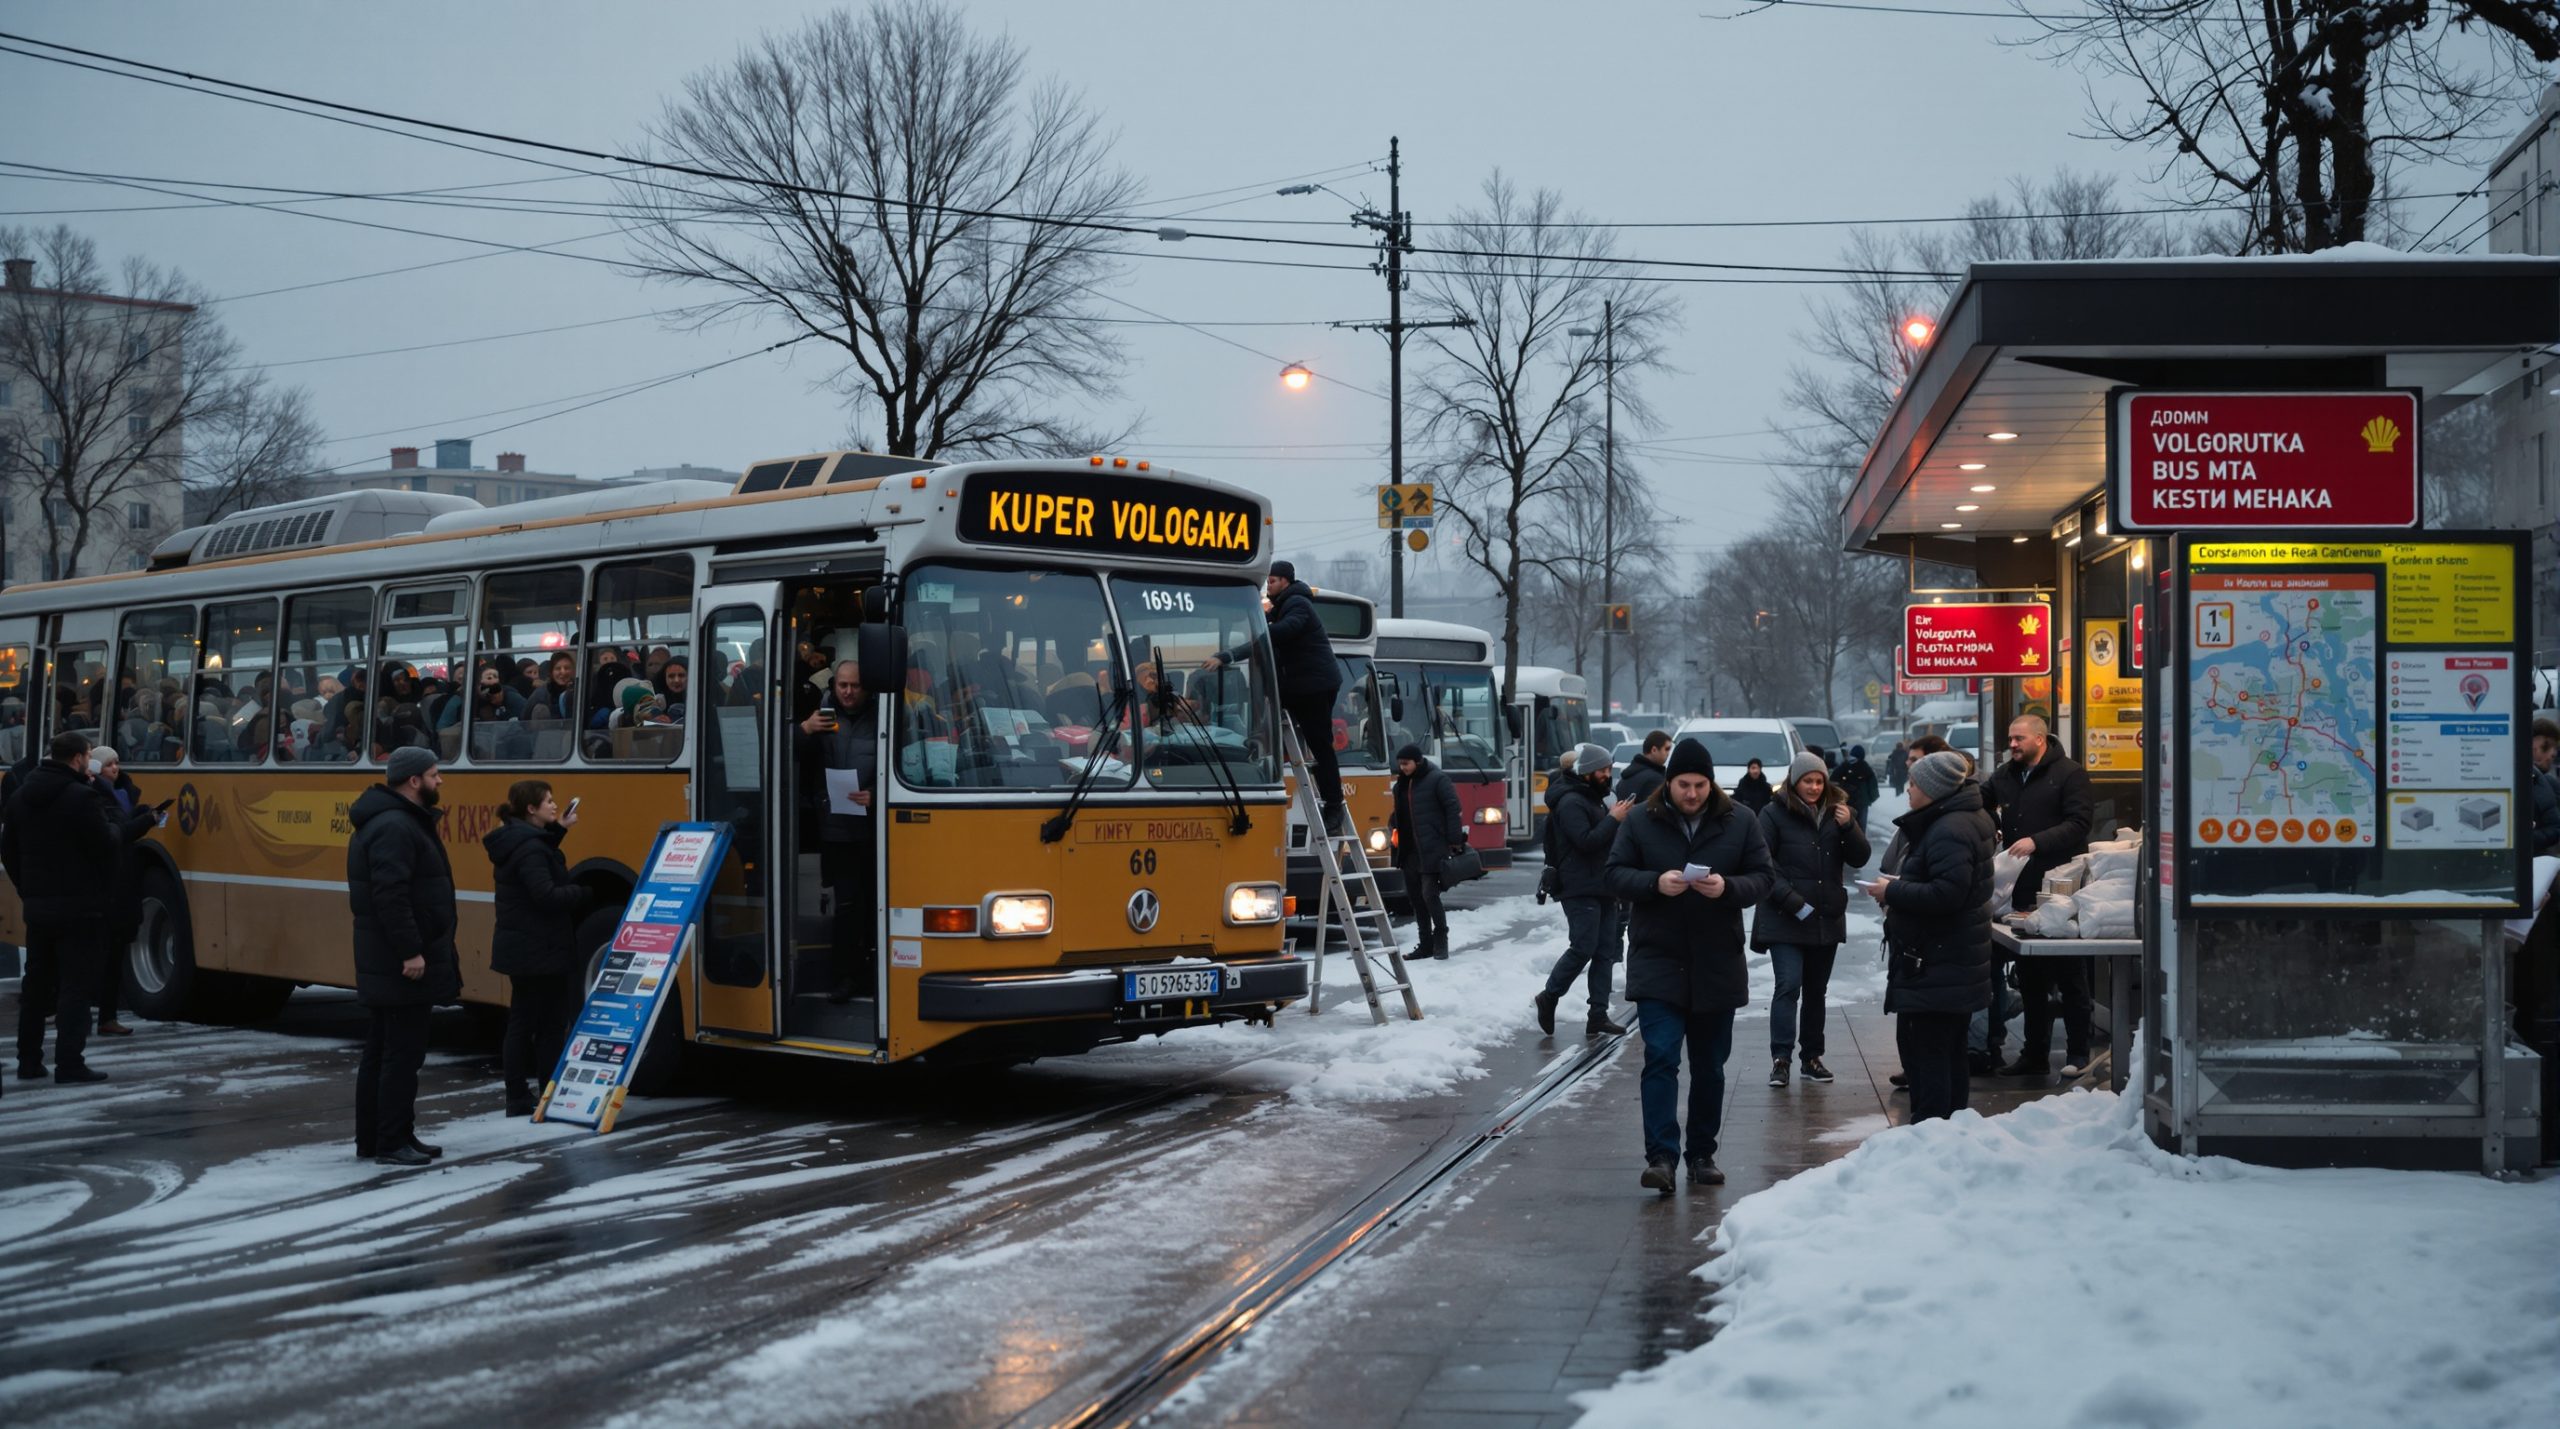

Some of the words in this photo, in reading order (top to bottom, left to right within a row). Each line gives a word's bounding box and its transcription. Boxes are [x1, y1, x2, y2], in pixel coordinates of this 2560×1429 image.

[2152, 432, 2305, 453] VOLGORUTKA
[2152, 460, 2200, 481] BUS
[2208, 460, 2257, 480] MTA
[2233, 488, 2333, 509] MEHAKA
[989, 490, 1095, 537] KUPER
[1112, 500, 1250, 551] VOLOGAKA
